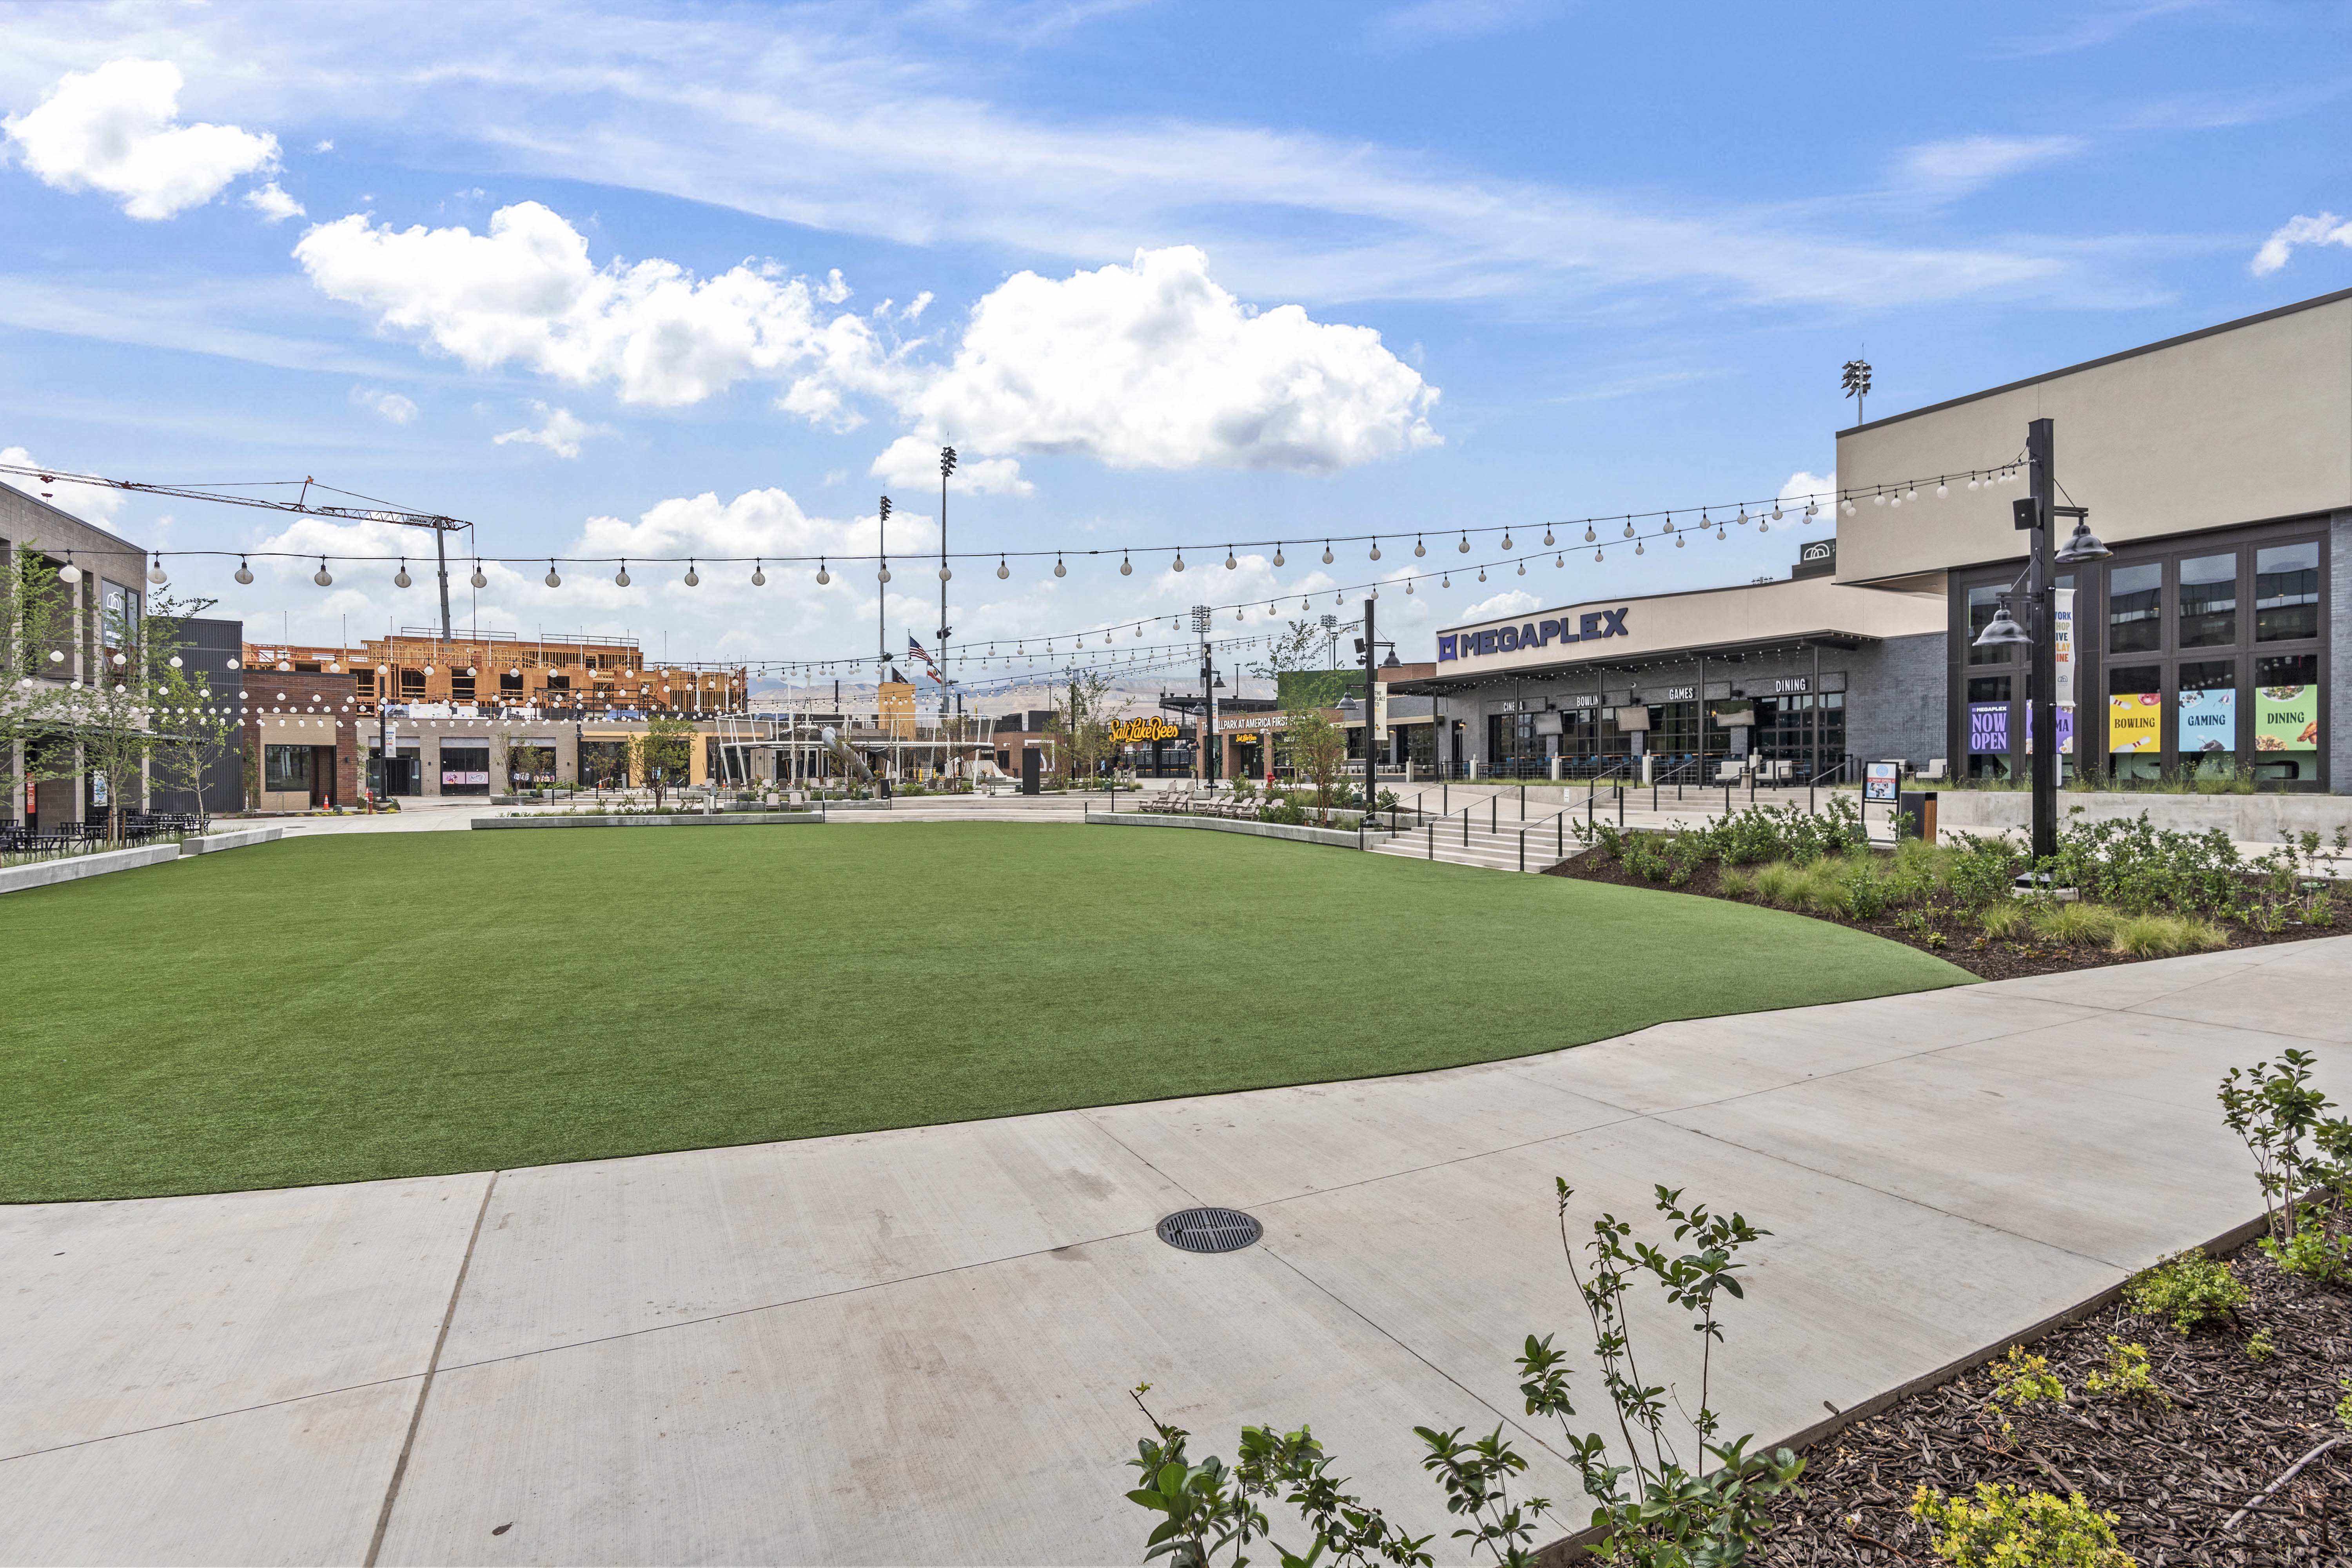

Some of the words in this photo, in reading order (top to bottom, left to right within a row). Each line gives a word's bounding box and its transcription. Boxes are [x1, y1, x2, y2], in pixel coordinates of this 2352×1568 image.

[2055, 612, 2071, 620] ORK
[2056, 622, 2070, 631] HOP
[1461, 608, 1628, 658] MEGAPLEX
[2056, 633, 2068, 641] IVE
[2056, 642, 2070, 652] LAY
[2056, 653, 2069, 662] INE
[1775, 678, 1806, 692] DINING
[1669, 687, 1693, 700] GAMES
[1503, 701, 1523, 712] CINEA
[1577, 695, 1598, 707] BOWLIN
[1219, 719, 1237, 730] LLPARK
[1238, 719, 1245, 729] AT
[1246, 717, 1271, 728] AMERICA
[1272, 716, 1289, 727] FIRST
[1972, 713, 2007, 733] NOW
[2114, 717, 2155, 729] BOWLING
[2187, 715, 2226, 726] GAMING
[2267, 712, 2305, 724] DINING
[1109, 719, 1130, 742] Salt
[1125, 717, 1152, 743] Lake
[1150, 716, 1179, 741] Bees
[1971, 732, 2007, 750] OPEN
